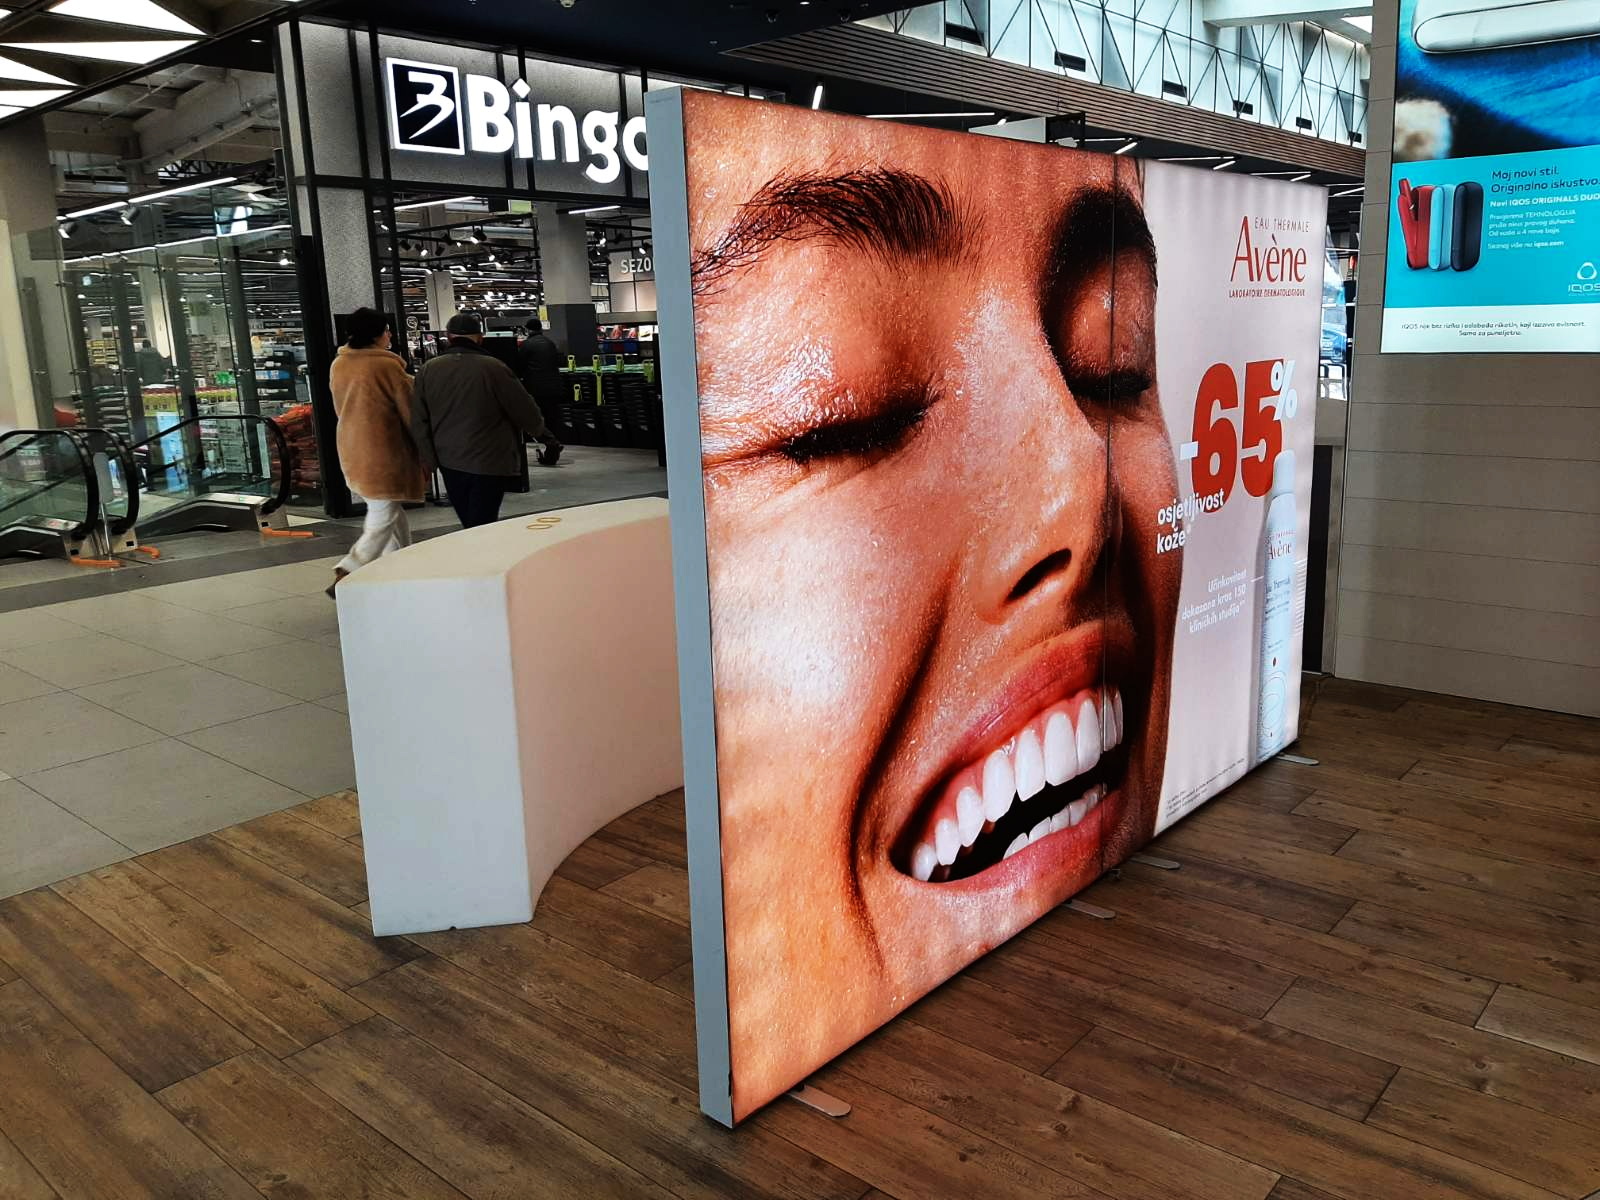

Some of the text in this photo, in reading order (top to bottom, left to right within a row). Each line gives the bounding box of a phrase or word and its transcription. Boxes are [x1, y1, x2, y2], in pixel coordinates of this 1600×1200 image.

[465, 73, 648, 184] Bingo
[1492, 170, 1512, 181] Moj
[1513, 168, 1537, 178] novi
[1491, 181, 1548, 195] Originalno
[1490, 193, 1600, 208] Novi IQOS ORIGINALS DUO
[1254, 216, 1310, 233] EAU THERMALE
[1230, 215, 1307, 283] Avène
[1229, 288, 1306, 298] LABORATOIRE DERMATOLOGIQUE
[1567, 283, 1600, 293] IQOS
[1157, 488, 1225, 528] osjetljivost
[1233, 584, 1247, 600] 150
